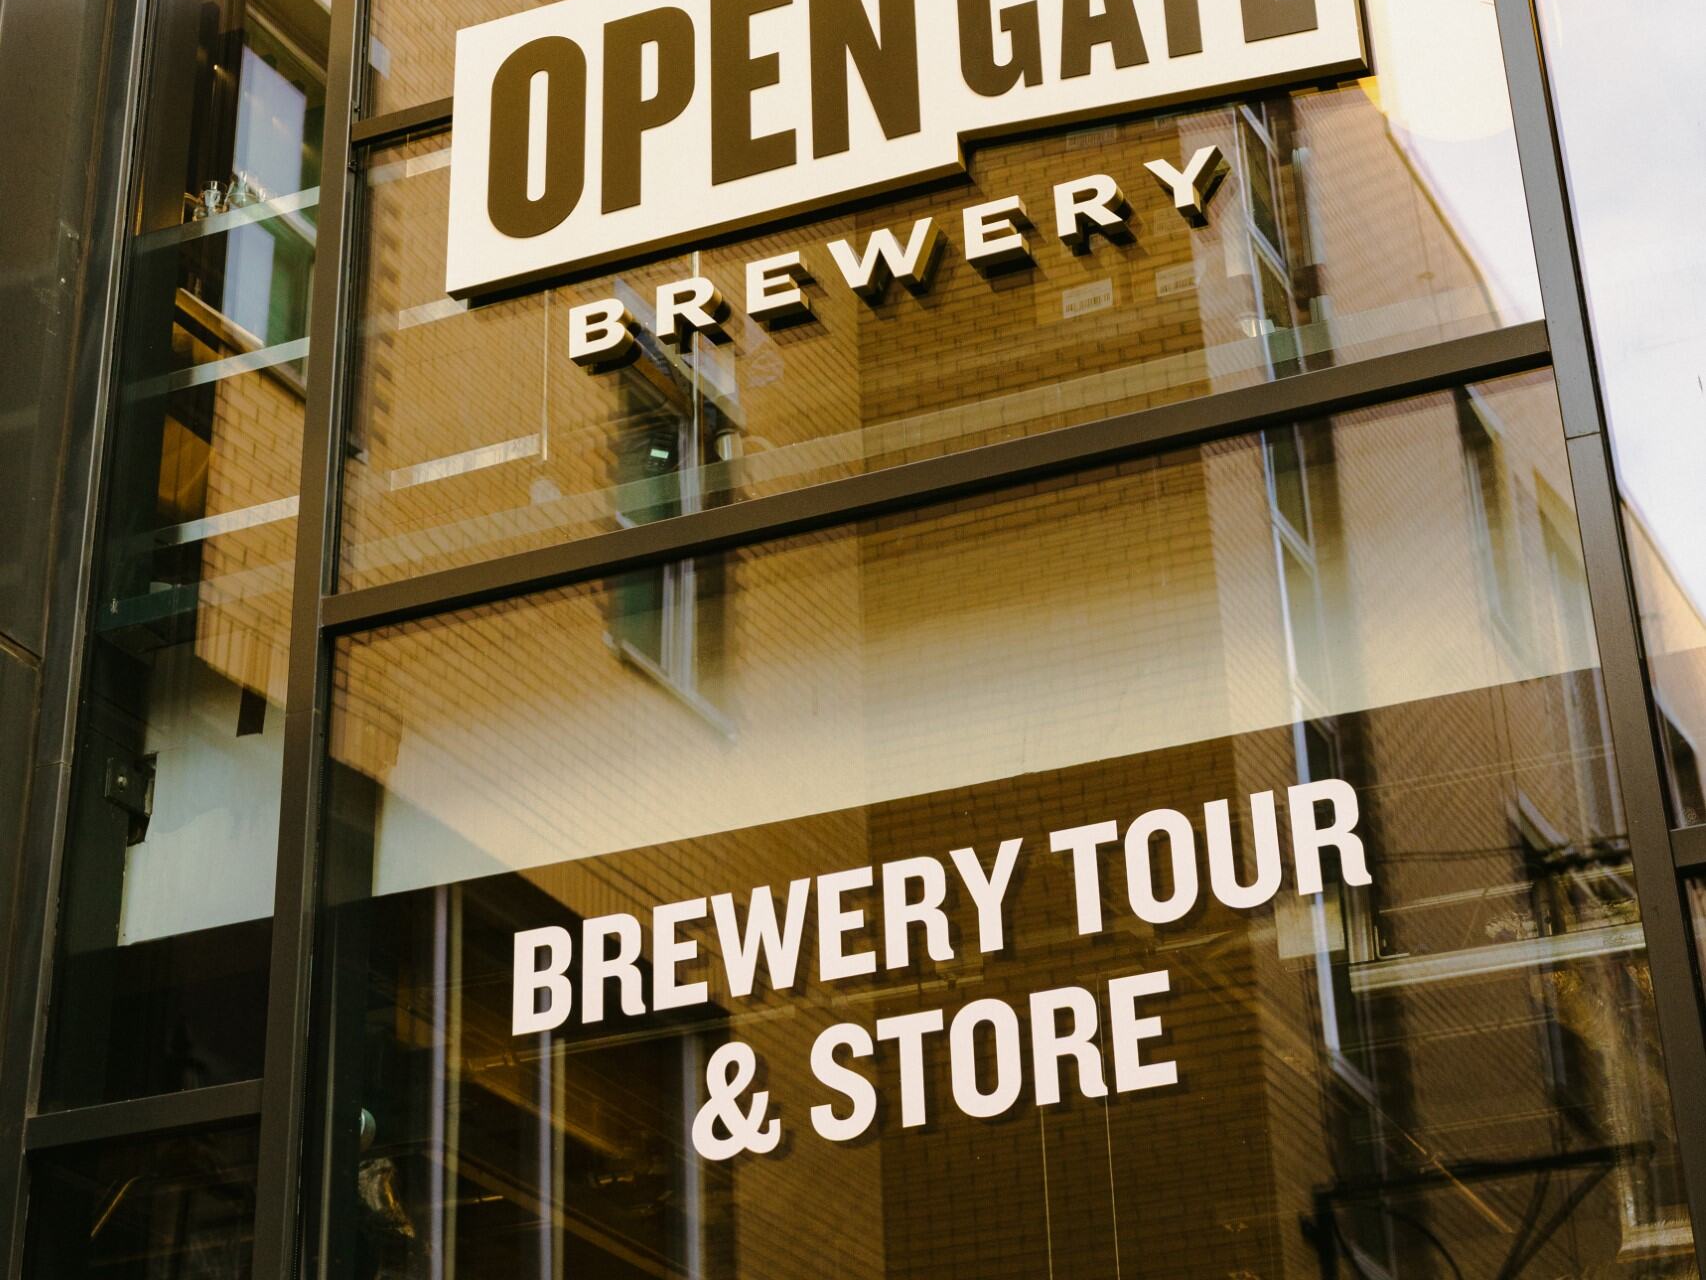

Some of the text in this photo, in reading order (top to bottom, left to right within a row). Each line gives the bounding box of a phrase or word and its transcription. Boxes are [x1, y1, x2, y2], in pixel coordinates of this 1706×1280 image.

[568, 144, 1221, 365] BREWERY
[511, 777, 1373, 1036] BREWERY TOUR
[691, 968, 1179, 1162] & STORE
